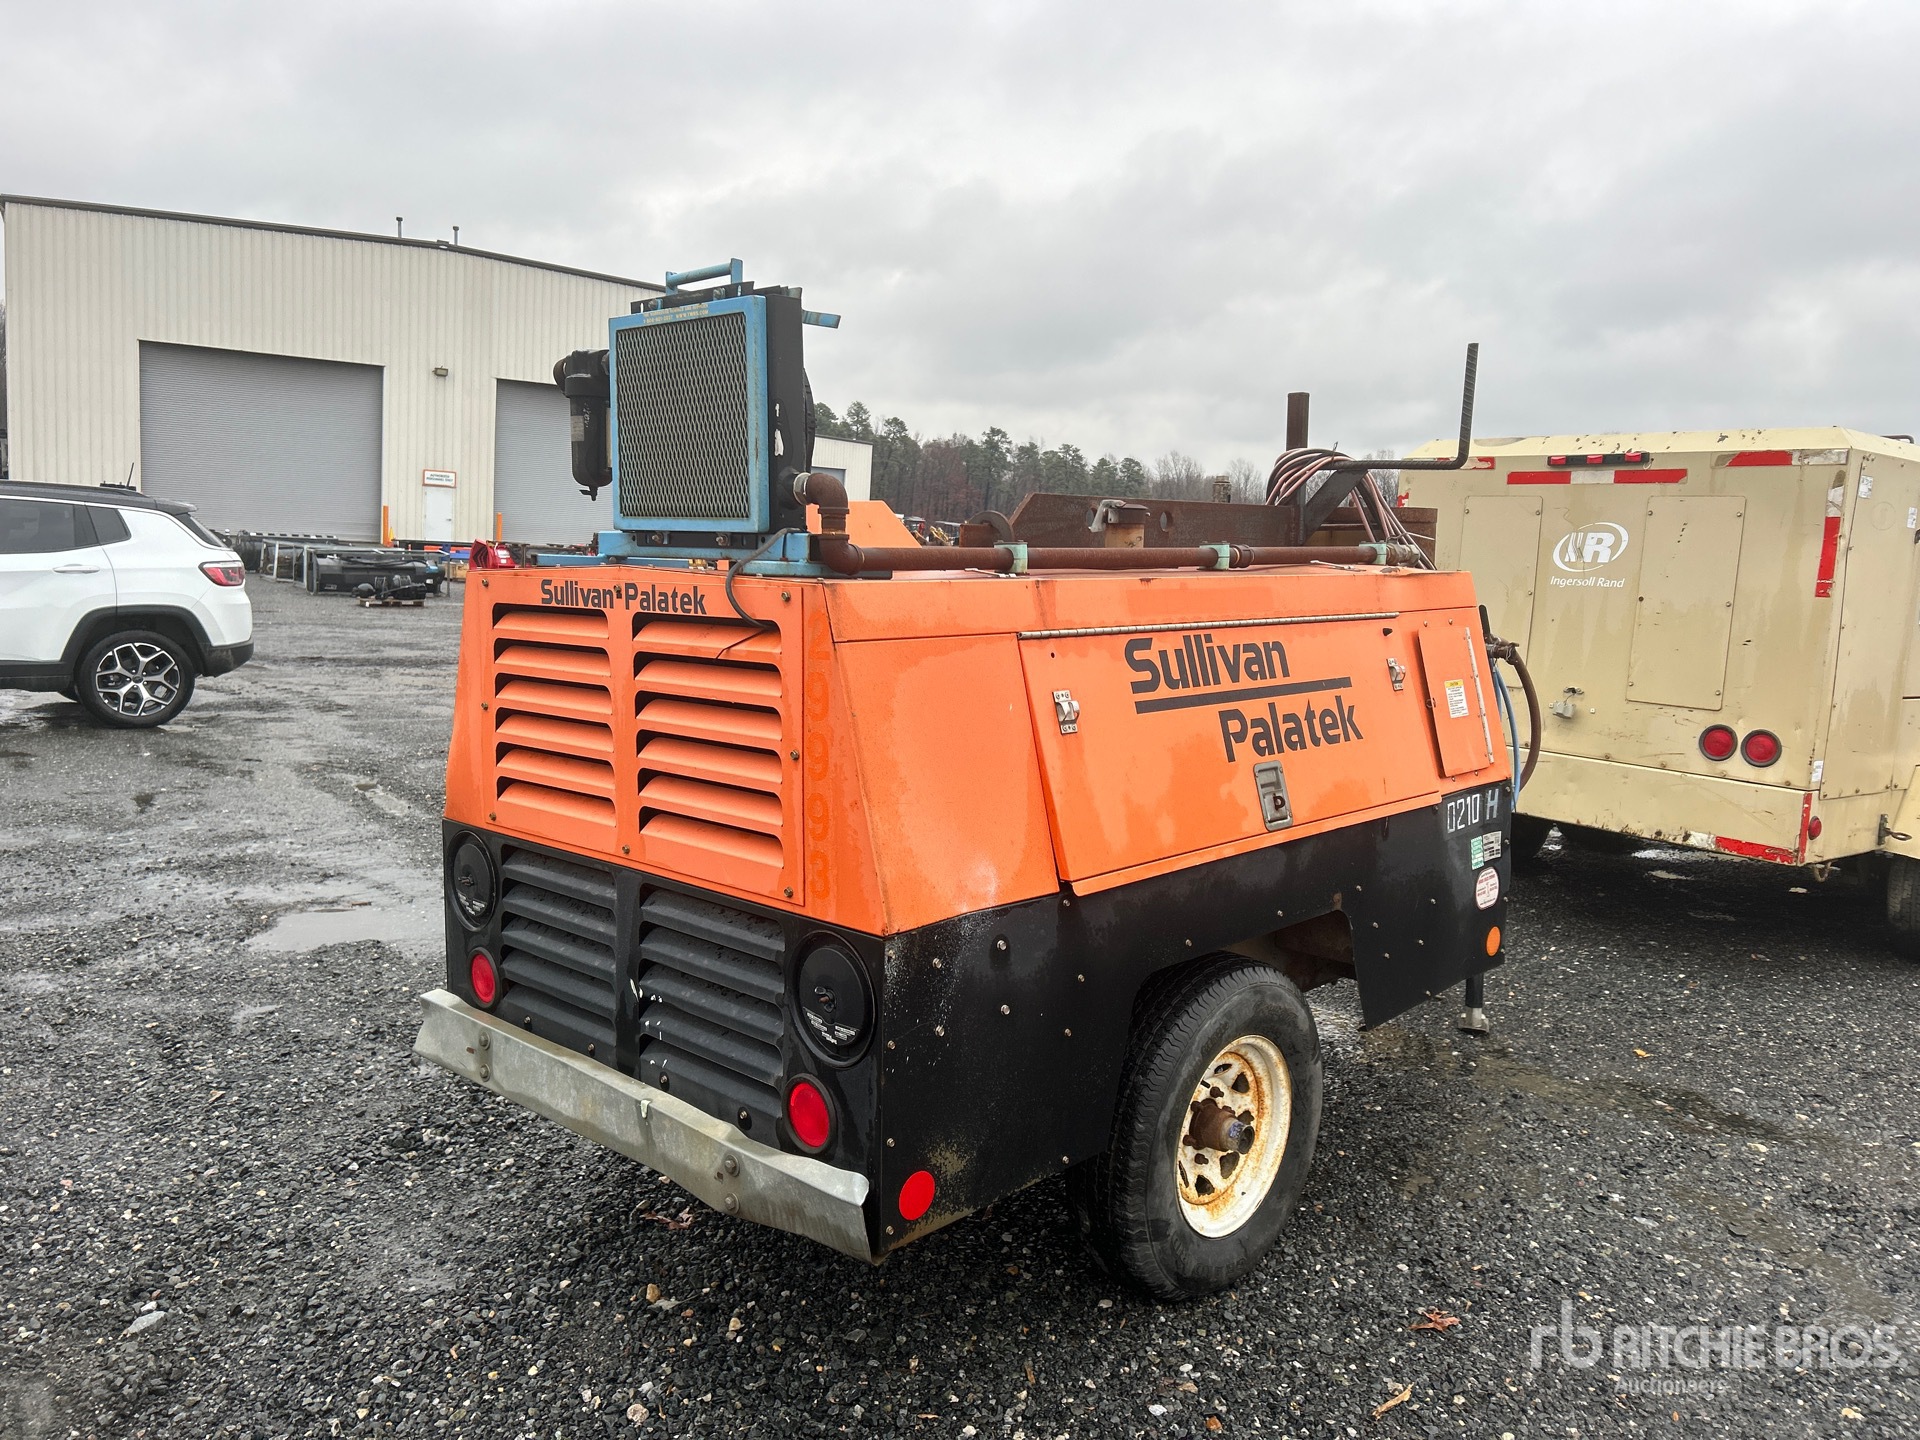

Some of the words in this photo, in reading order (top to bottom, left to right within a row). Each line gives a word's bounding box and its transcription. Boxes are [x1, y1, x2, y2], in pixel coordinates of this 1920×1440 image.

[541, 578, 615, 610] Sullivan
[624, 582, 707, 615] Palatek
[1550, 576, 1595, 588] Ingersoll
[1597, 577, 1625, 588] Rand
[1124, 634, 1291, 694] Sullivan
[1218, 695, 1364, 762] Palatek
